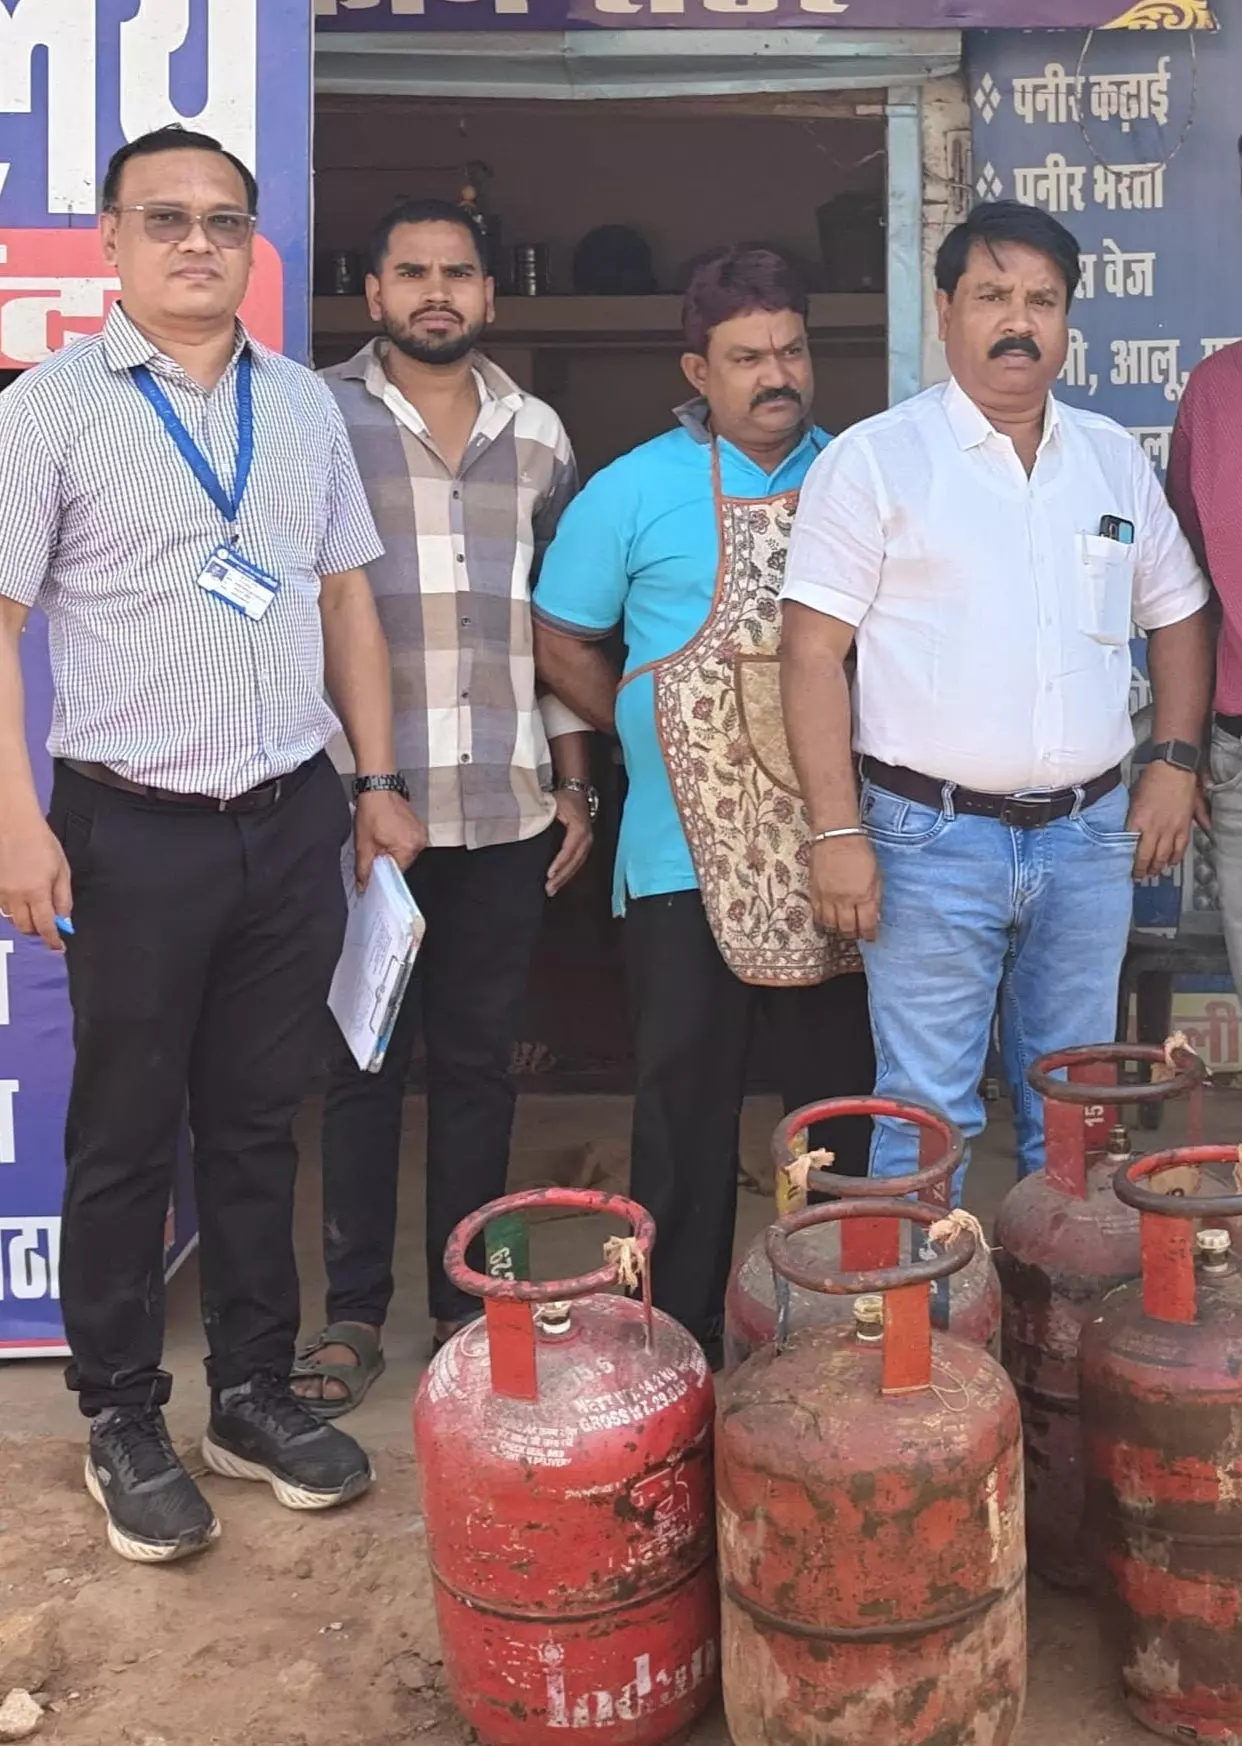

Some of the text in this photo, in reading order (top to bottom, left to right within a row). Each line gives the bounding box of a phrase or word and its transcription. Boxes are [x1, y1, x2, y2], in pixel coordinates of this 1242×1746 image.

[1012, 62, 1085, 123] पनीर
[1013, 153, 1167, 212] पनीर भरता
[1103, 238, 1156, 298] वेज
[578, 1407, 632, 1433] GROSS
